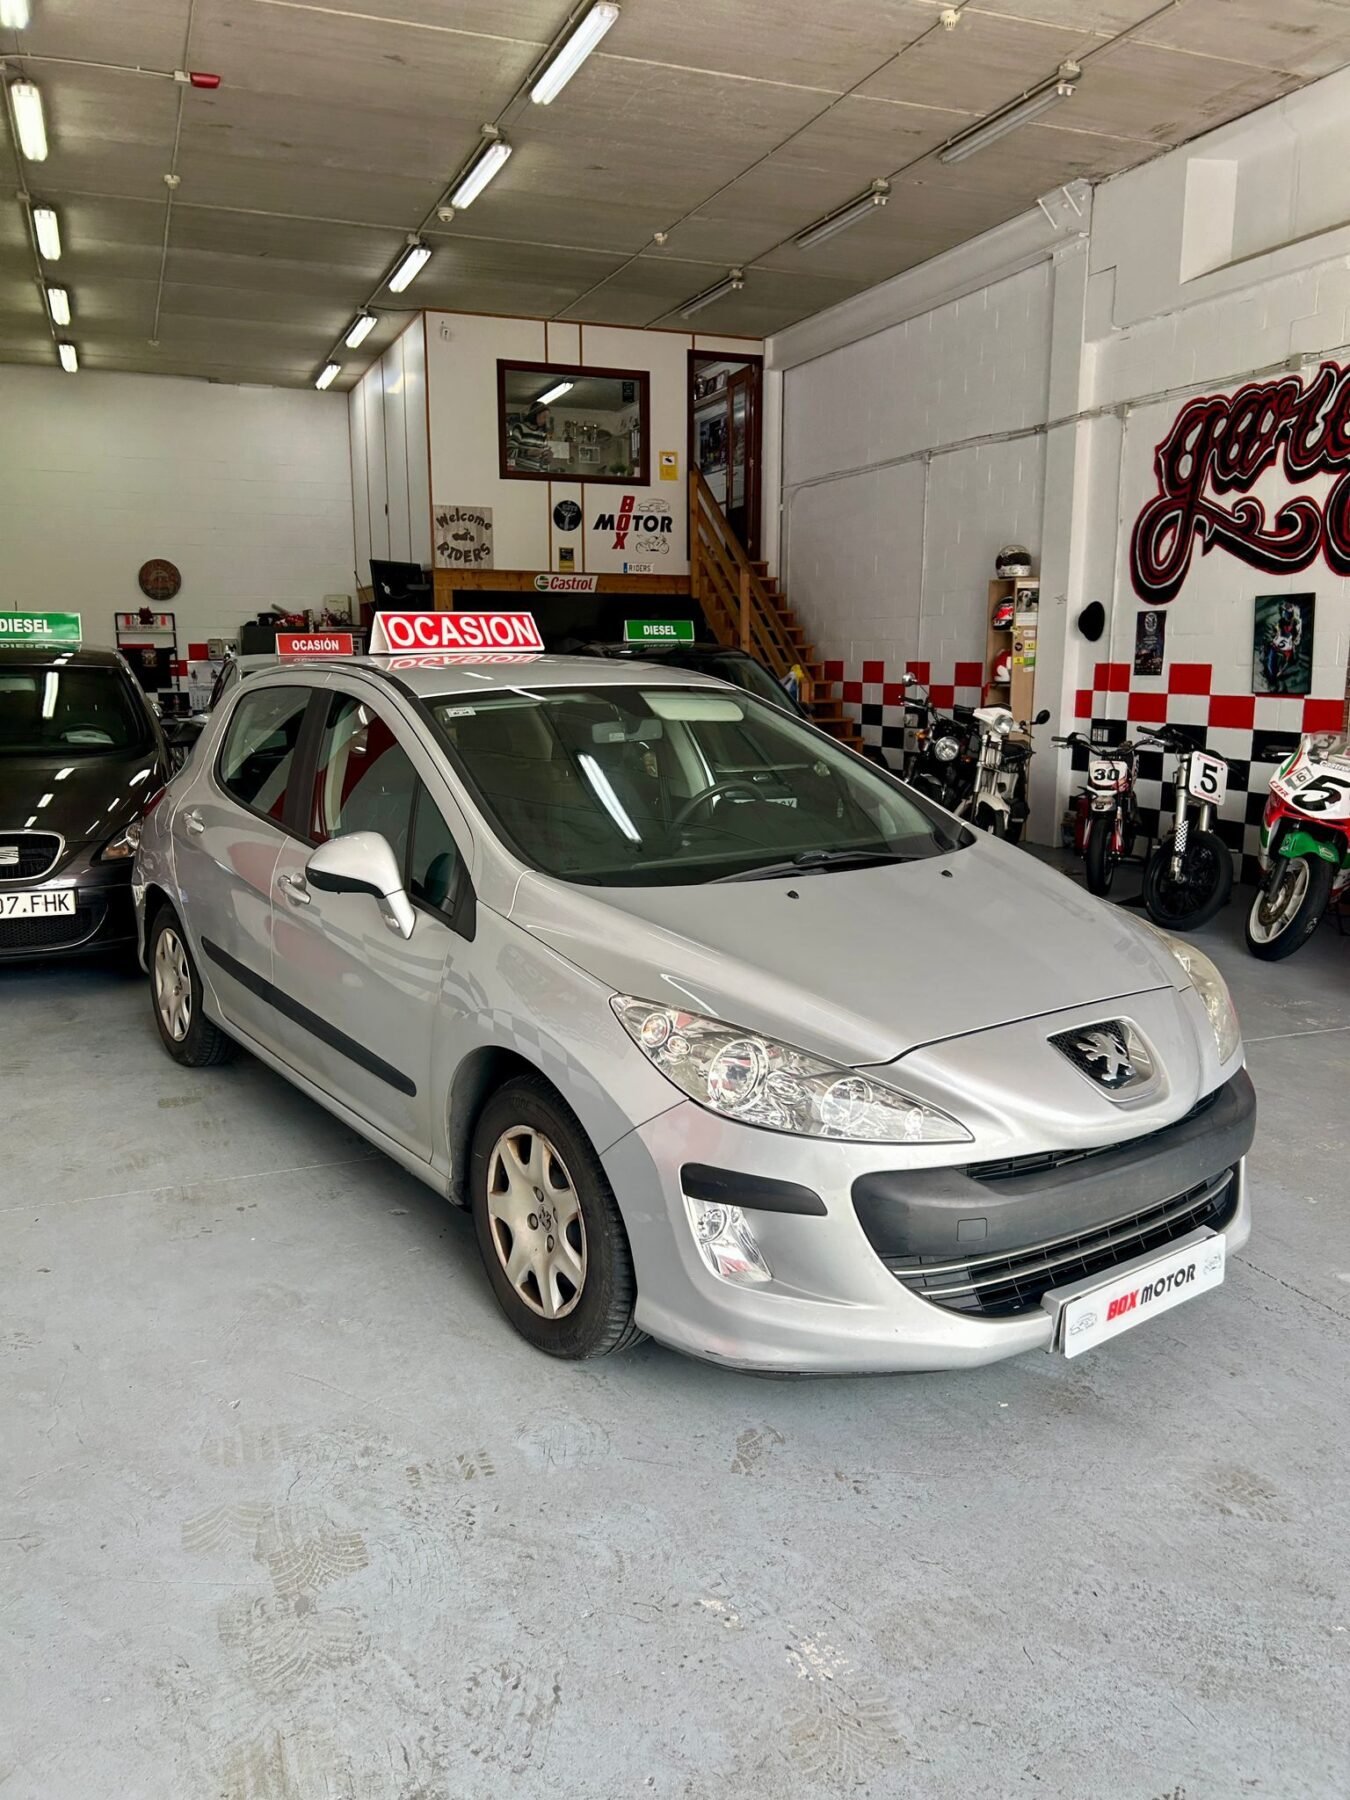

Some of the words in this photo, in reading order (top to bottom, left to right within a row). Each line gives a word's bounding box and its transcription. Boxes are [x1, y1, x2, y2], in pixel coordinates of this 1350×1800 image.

[436, 507, 492, 530] Welcome
[593, 513, 672, 533] MOTOR
[612, 495, 635, 550] BOX
[437, 541, 491, 563] RIDERS
[628, 564, 651, 573] RIDERS
[550, 575, 593, 590] Castrol
[0, 618, 53, 633] DIESEL
[387, 616, 538, 647] OCASION
[643, 625, 677, 636] DIESEL
[291, 637, 340, 651] OCASIÓN
[1094, 768, 1120, 781] 30
[1200, 763, 1218, 794] 5
[1291, 775, 1350, 812] 5
[1107, 1288, 1140, 1321] BOX
[1140, 1263, 1196, 1305] MOTOR
